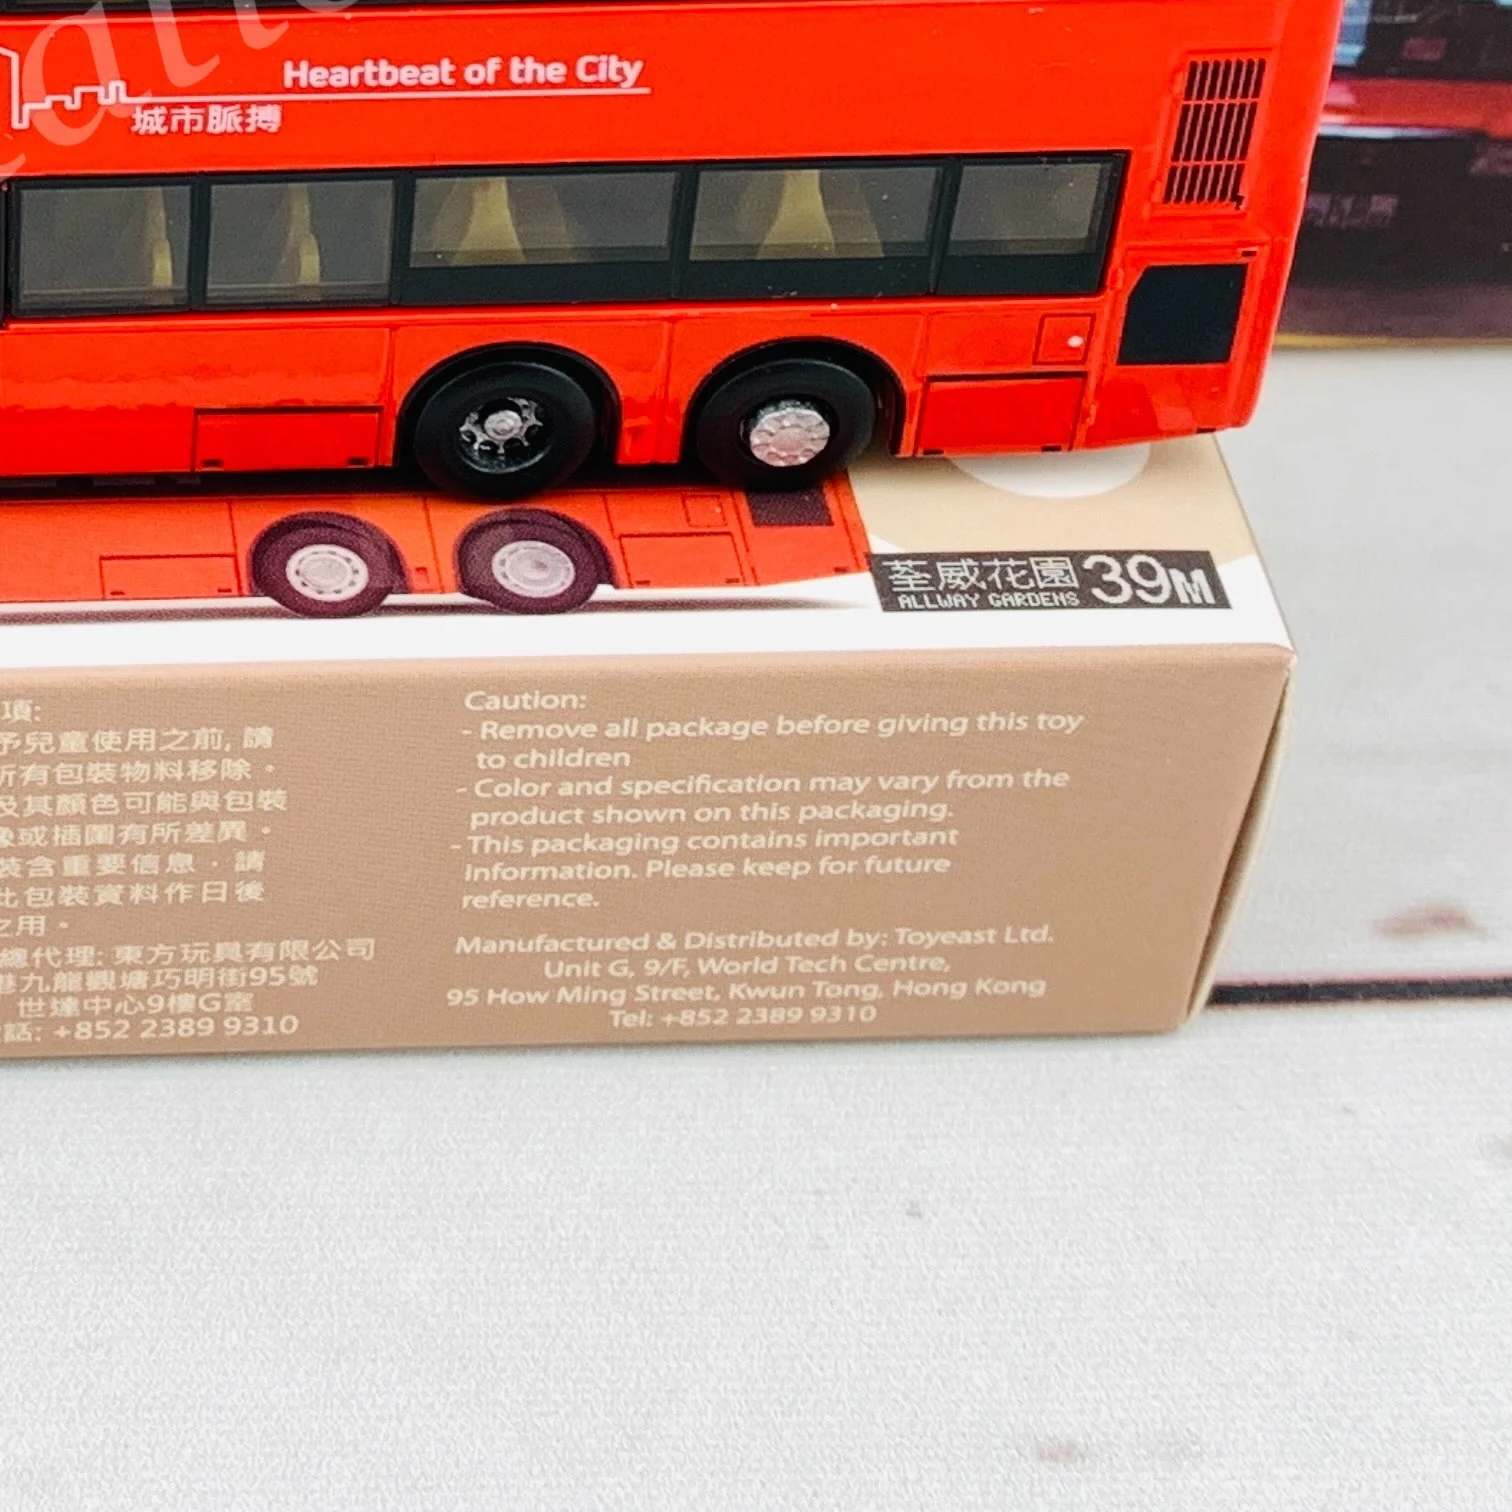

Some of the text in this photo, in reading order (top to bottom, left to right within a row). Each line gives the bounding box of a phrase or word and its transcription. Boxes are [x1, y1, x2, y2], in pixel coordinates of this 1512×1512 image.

[283, 54, 645, 88] Heartbeat of the City
[131, 105, 283, 135] 城市脈搏
[882, 554, 1216, 605] 荃威花園 39M
[898, 590, 1081, 610] ALLWAY GARDENS
[464, 690, 588, 711] Caution:
[480, 720, 598, 739] Remove
[605, 718, 638, 737] all
[646, 716, 768, 741] package
[776, 715, 871, 736] before
[877, 713, 968, 737] giving
[976, 711, 1029, 732] this
[1037, 712, 1085, 735] toy
[476, 747, 631, 770] to children
[474, 778, 551, 799] Color
[557, 776, 613, 797] and
[620, 774, 801, 799] specification
[808, 774, 871, 795] may
[878, 773, 939, 795] vary
[946, 769, 1014, 789] from
[1022, 768, 1071, 789] the
[470, 800, 954, 830] product shown on this packaging.
[467, 835, 524, 855] This
[531, 833, 680, 858] packaging
[687, 831, 807, 850] contains
[815, 827, 960, 852] important
[464, 854, 951, 883] Information. Please keep for future
[462, 890, 599, 909] reference.
[455, 924, 1054, 955] Manufactured & Distributed by: Toyeast Ltd.
[543, 954, 951, 979] Unit G, 9/F, World Tech Centre,
[446, 977, 1048, 1007] 95 How Ming Street, Kwun Tong, Hong Kong
[53, 1018, 130, 1040] +852
[140, 1016, 215, 1038] 2389
[223, 1014, 299, 1036] 9310
[609, 1004, 878, 1029] Tel: +852 2389 9310
